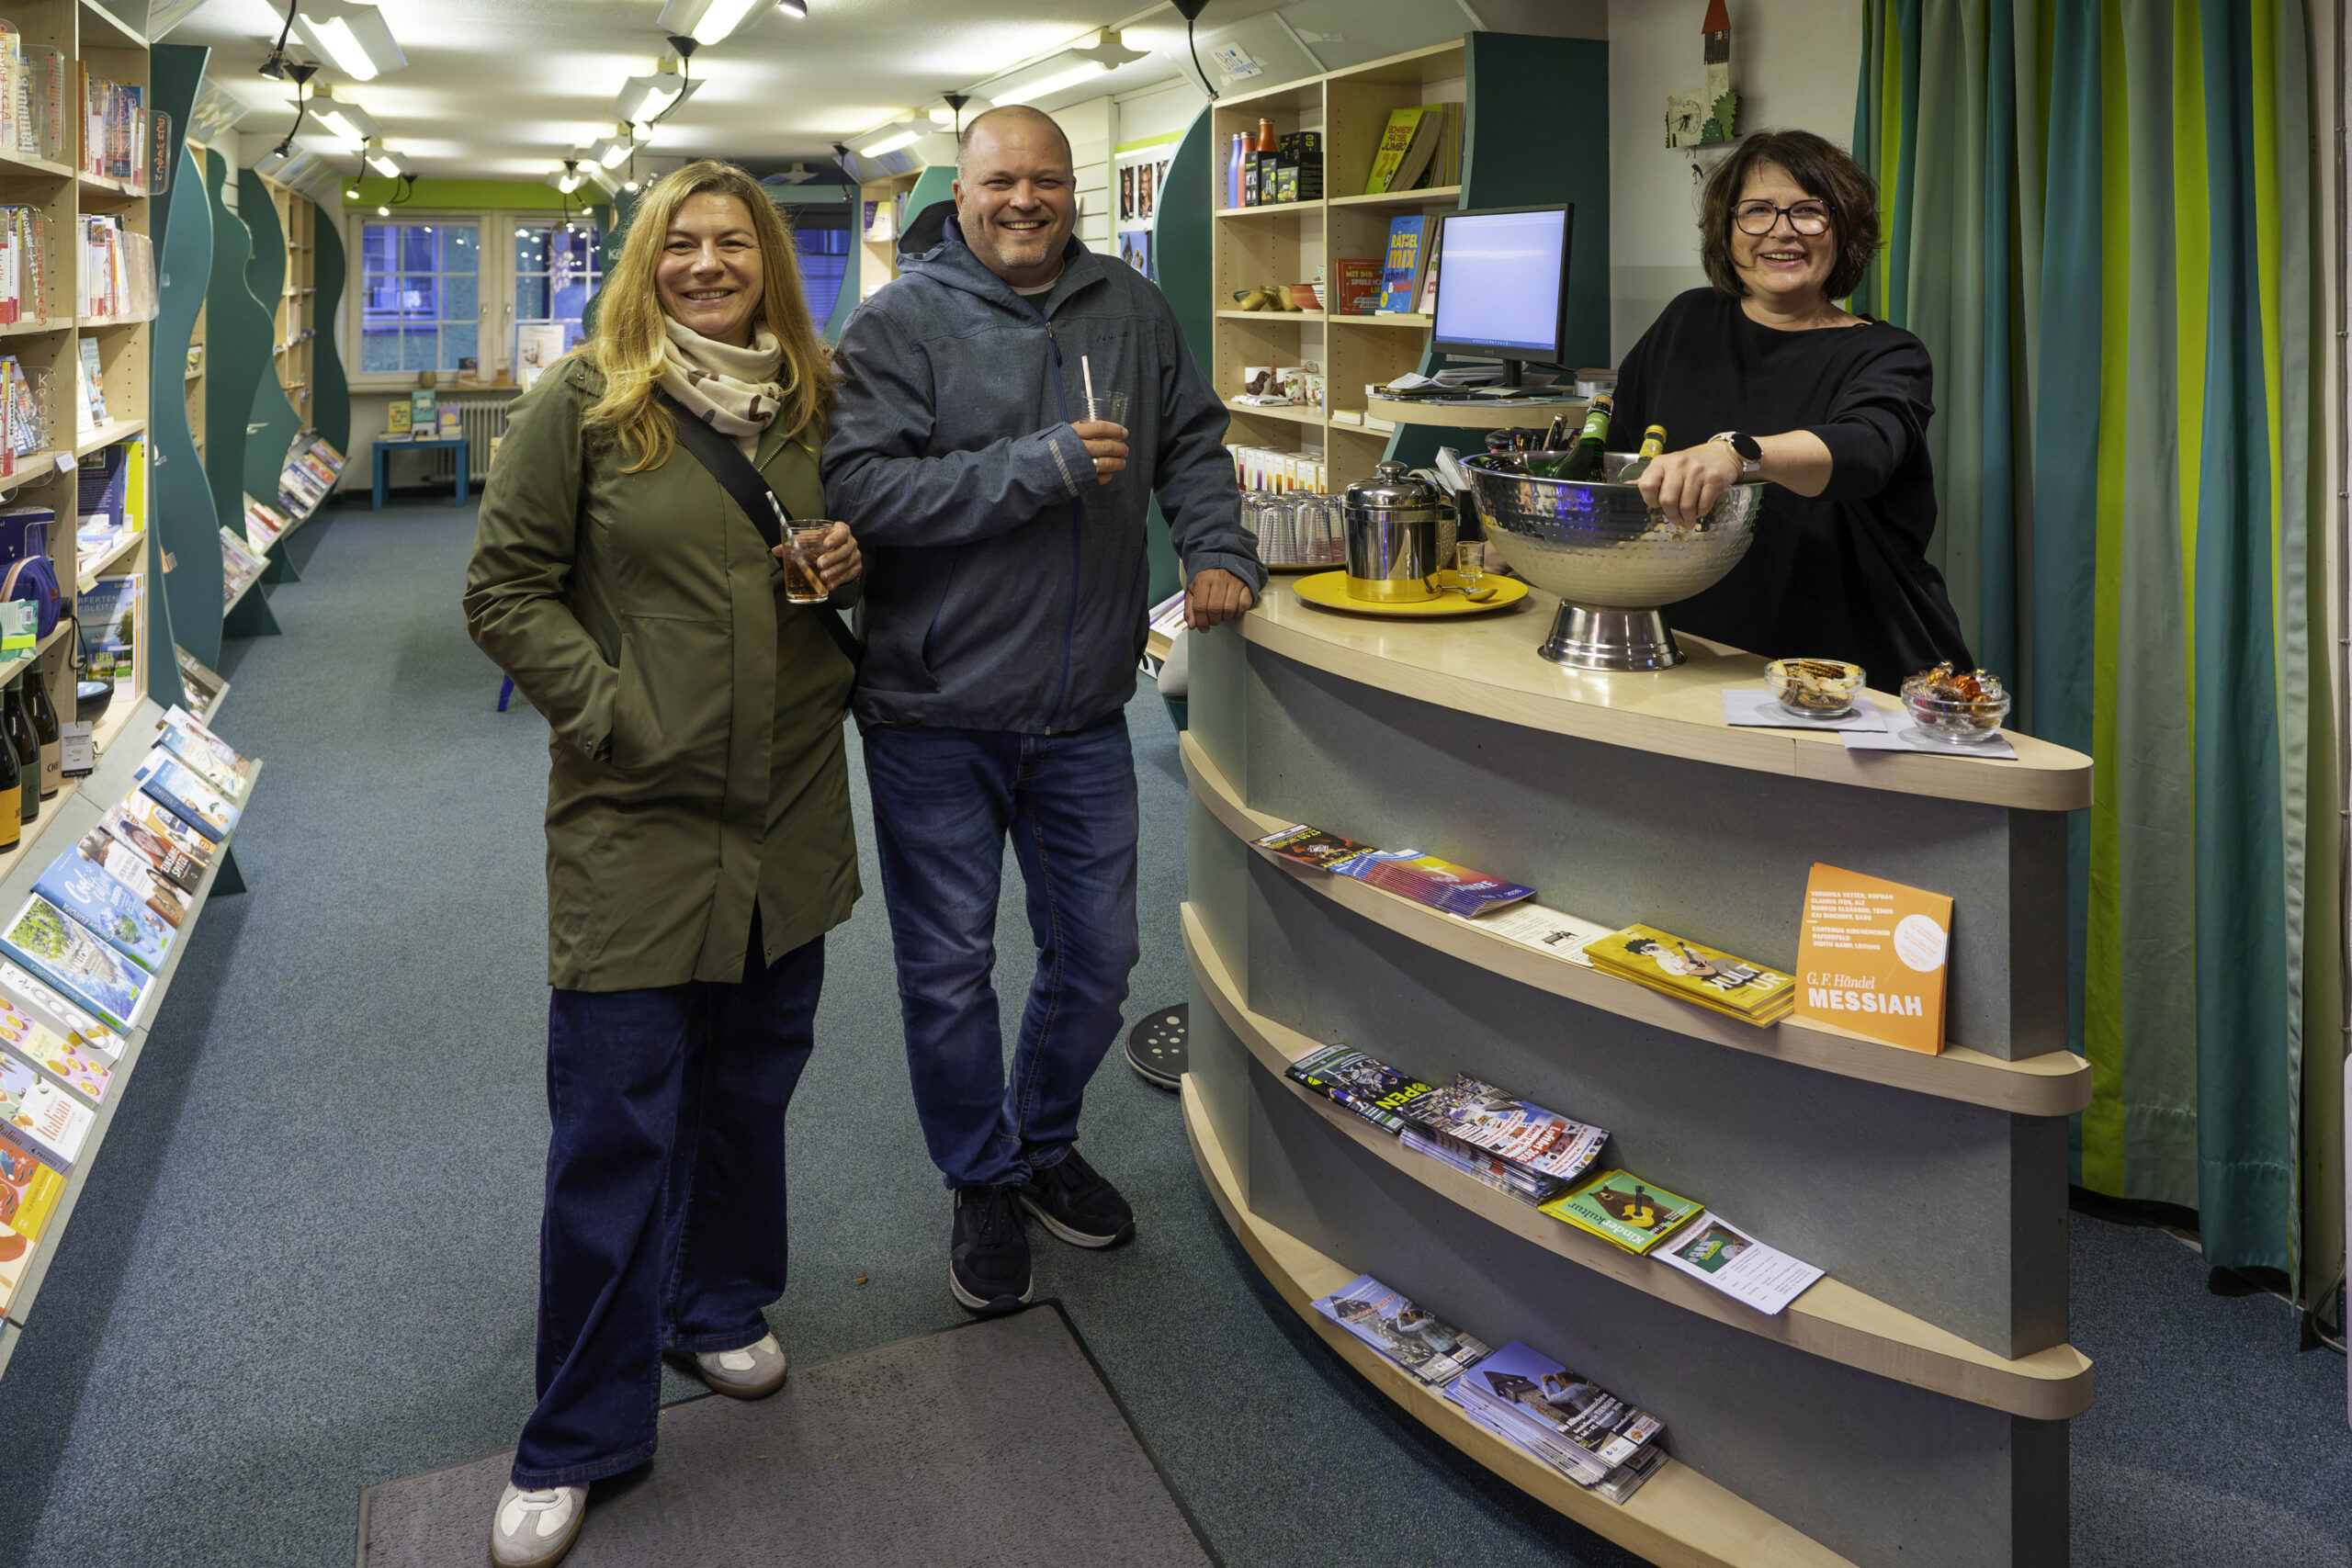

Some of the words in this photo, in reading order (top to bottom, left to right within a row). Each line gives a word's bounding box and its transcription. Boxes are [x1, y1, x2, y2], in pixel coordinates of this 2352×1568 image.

[1381, 142, 1407, 152] JUMBO
[1390, 231, 1418, 249] RÄTSEL
[33, 220, 46, 326] GRIECHENLAND
[1385, 267, 1409, 283] schnell
[1393, 278, 1413, 293] leicht
[78, 595, 119, 604] RFEKTEN
[79, 603, 121, 613] EGLEITER
[171, 853, 189, 878] SPITZE
[62, 902, 90, 927] EUROPA
[1872, 907, 1894, 915] TENOR
[1854, 942, 1881, 951] LEITUNG
[1746, 972, 1789, 991] UR
[1806, 971, 1819, 986] G.
[1821, 972, 1832, 987] F.
[1833, 974, 1876, 990] Händel
[1807, 987, 1923, 1017] MESSIAH
[36, 1100, 72, 1142] Italian
[1538, 1125, 1561, 1150] LuftArt
[1567, 1202, 1645, 1245] Kinderkultur
[1557, 1424, 1570, 1432] Die
[1566, 1393, 1608, 1427] Alltagsmenschen
[1594, 1396, 1617, 1416] TIENGEN
